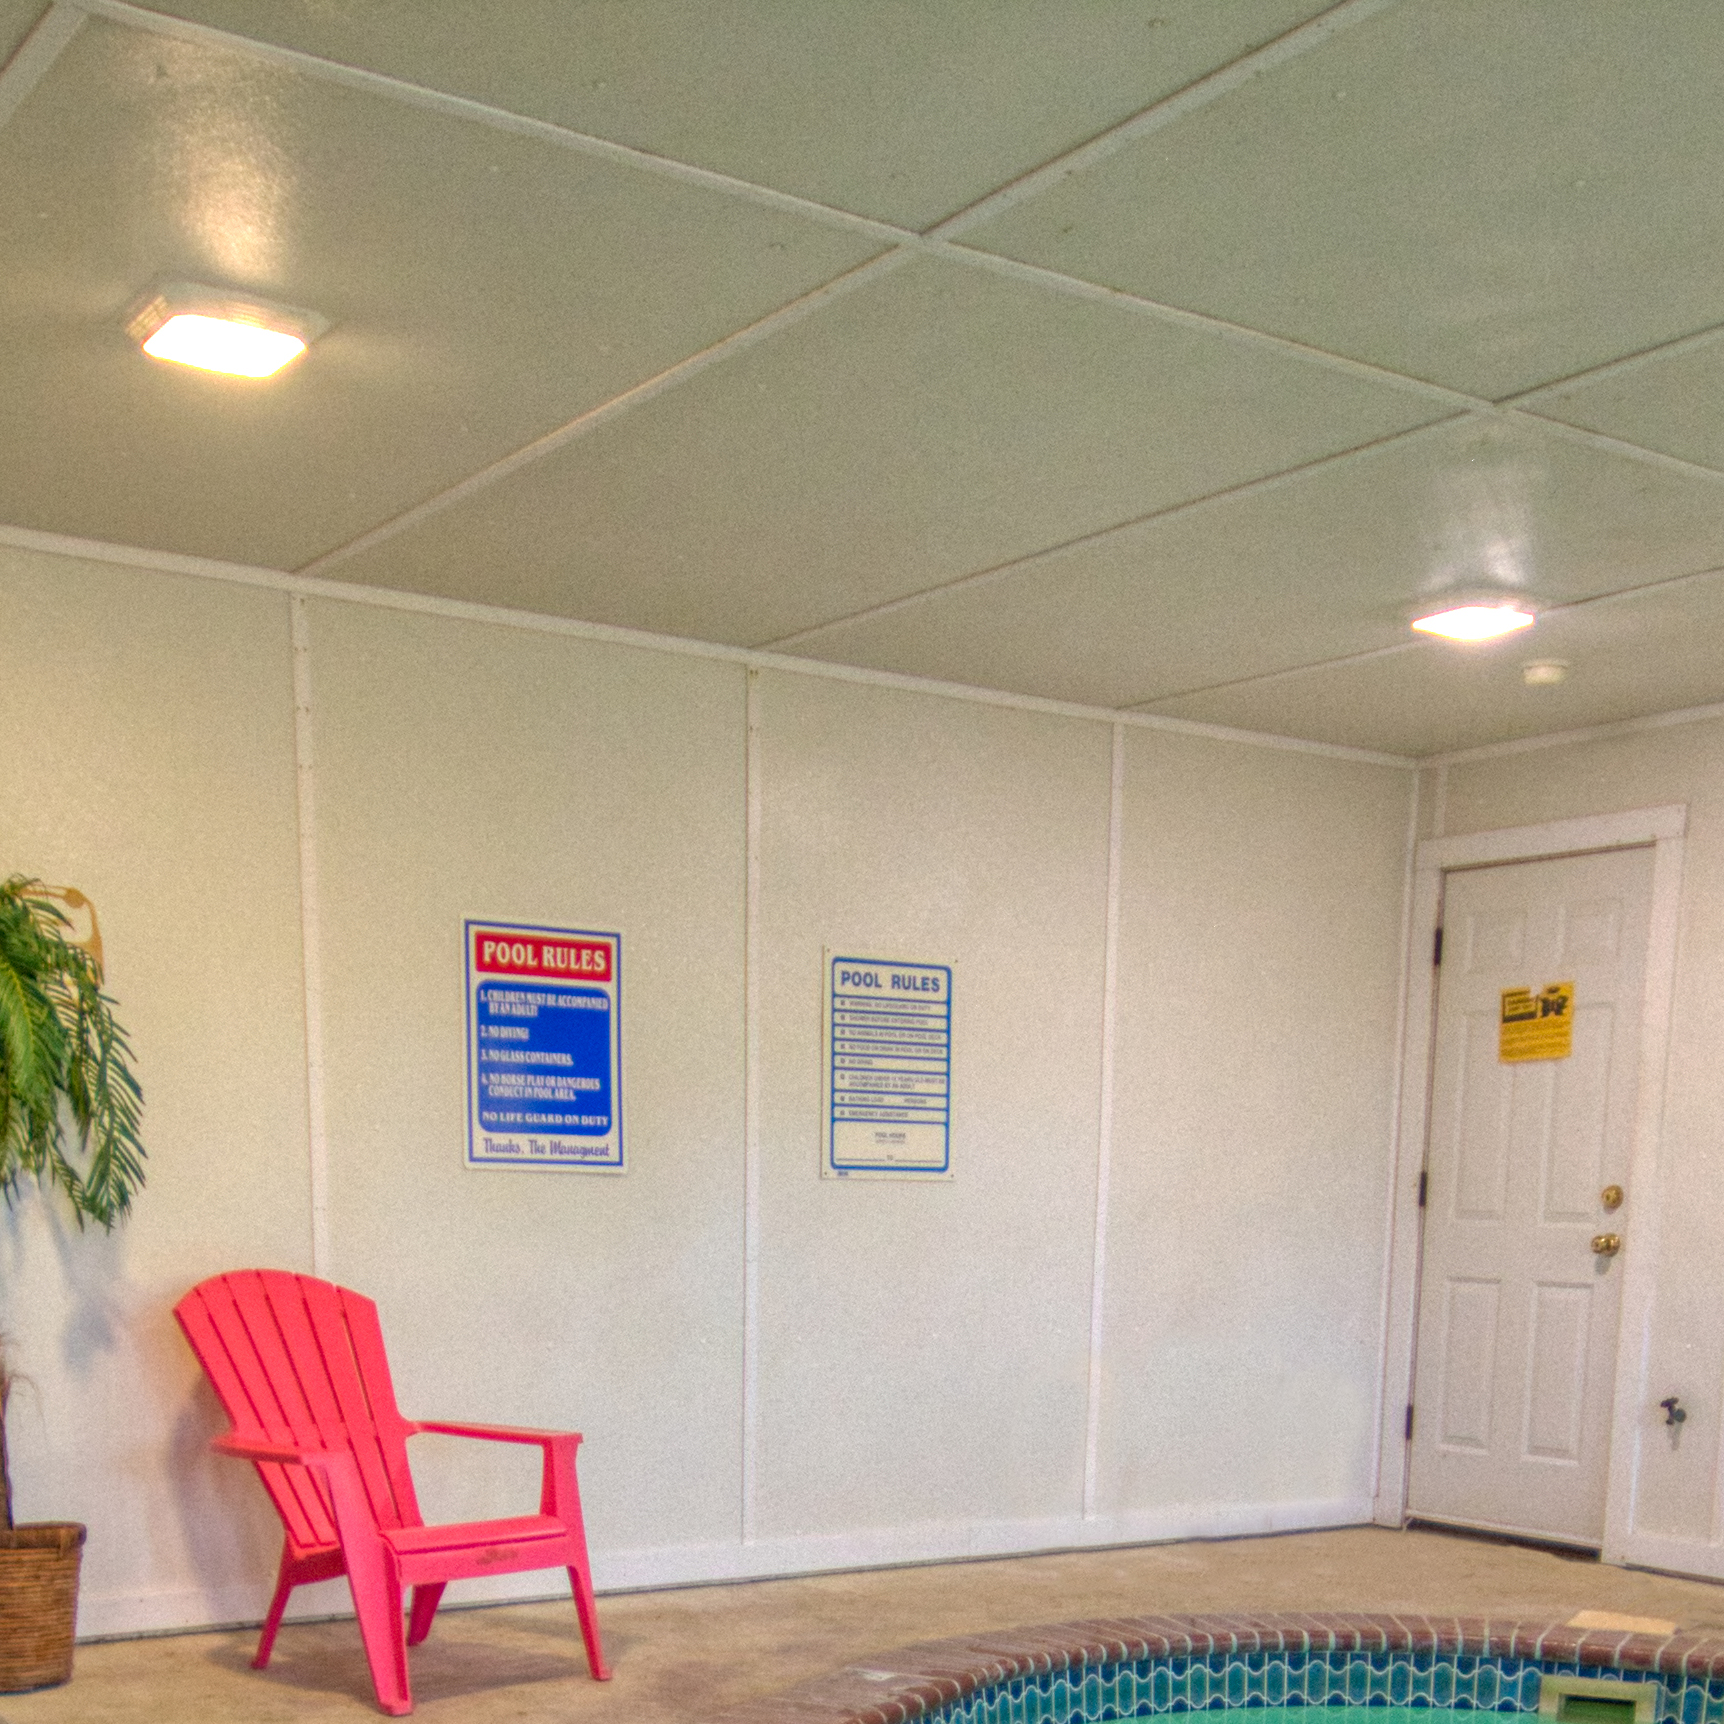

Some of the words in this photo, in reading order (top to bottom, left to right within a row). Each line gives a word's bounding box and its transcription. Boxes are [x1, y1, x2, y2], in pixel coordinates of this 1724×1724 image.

[483, 940, 538, 967] POOL
[542, 945, 606, 971] RULES
[841, 970, 882, 988] POOL
[891, 973, 940, 992] RULES
[487, 989, 525, 1004] CHILDREN
[526, 992, 546, 1005] MUST
[547, 994, 556, 1006] BE
[557, 995, 608, 1010] ACCOMPANIED
[500, 1002, 510, 1015] AN
[480, 1025, 487, 1038] 2.
[488, 1026, 499, 1038] NO
[489, 1049, 499, 1061] NO
[500, 1050, 524, 1063] GLASS
[489, 1073, 500, 1084] NO
[501, 1074, 525, 1086] HORSE
[527, 1075, 544, 1087] PLAY
[545, 1076, 556, 1087] OR
[556, 1076, 601, 1090] DANGEROUS
[488, 1085, 523, 1098] CONDUCT
[525, 1087, 533, 1098] IN
[533, 1087, 553, 1099] POOL
[482, 1111, 497, 1121] NO
[499, 1111, 522, 1122] LIFE
[525, 1112, 562, 1123] GUARD
[565, 1113, 579, 1124] ON
[581, 1115, 609, 1126] DUTY
[528, 1138, 546, 1154] The
